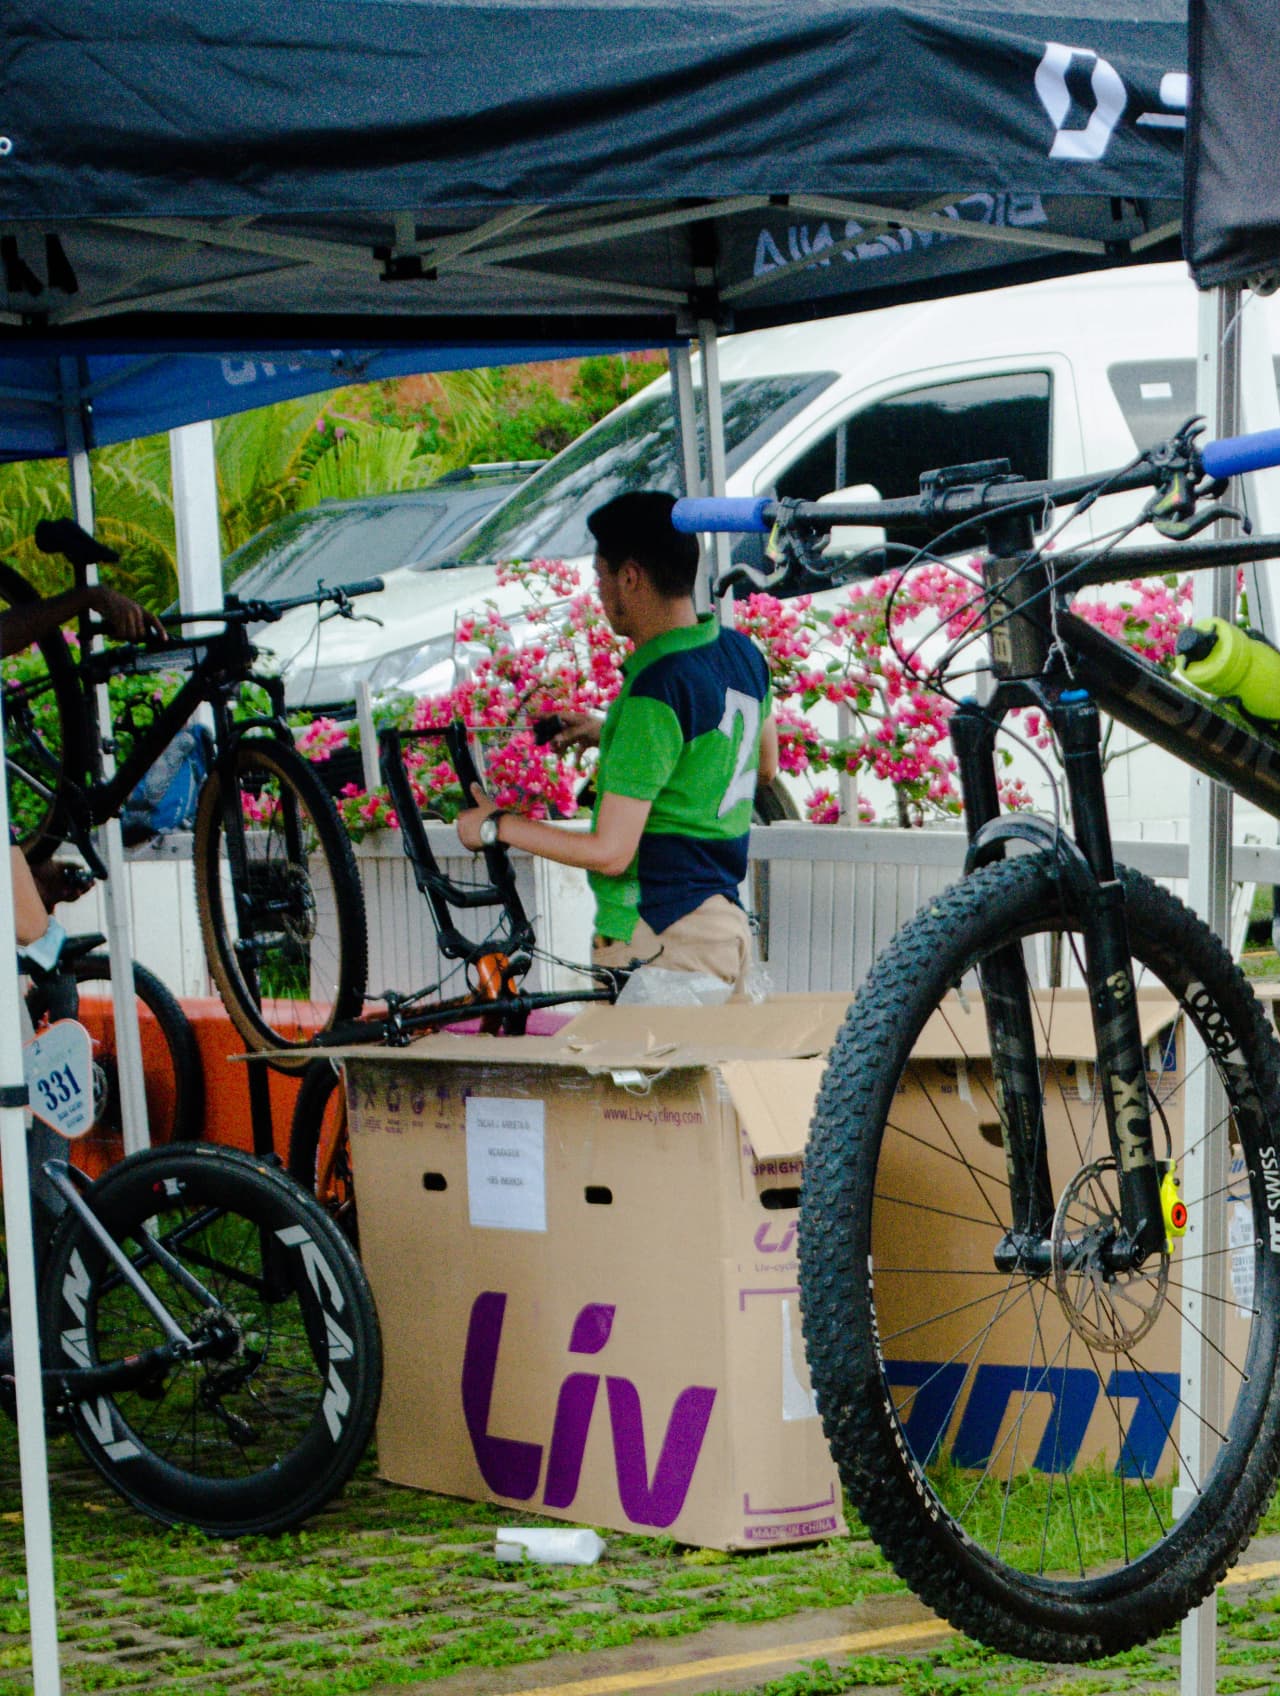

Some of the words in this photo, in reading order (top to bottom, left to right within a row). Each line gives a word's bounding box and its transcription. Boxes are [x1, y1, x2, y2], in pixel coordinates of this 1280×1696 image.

[37, 1063, 82, 1111] 331
[603, 1107, 702, 1127] www.Liv-cycling.com
[753, 1220, 799, 1253] Li
[460, 1290, 718, 1529] Liv
[802, 1519, 834, 1535] CHINA
